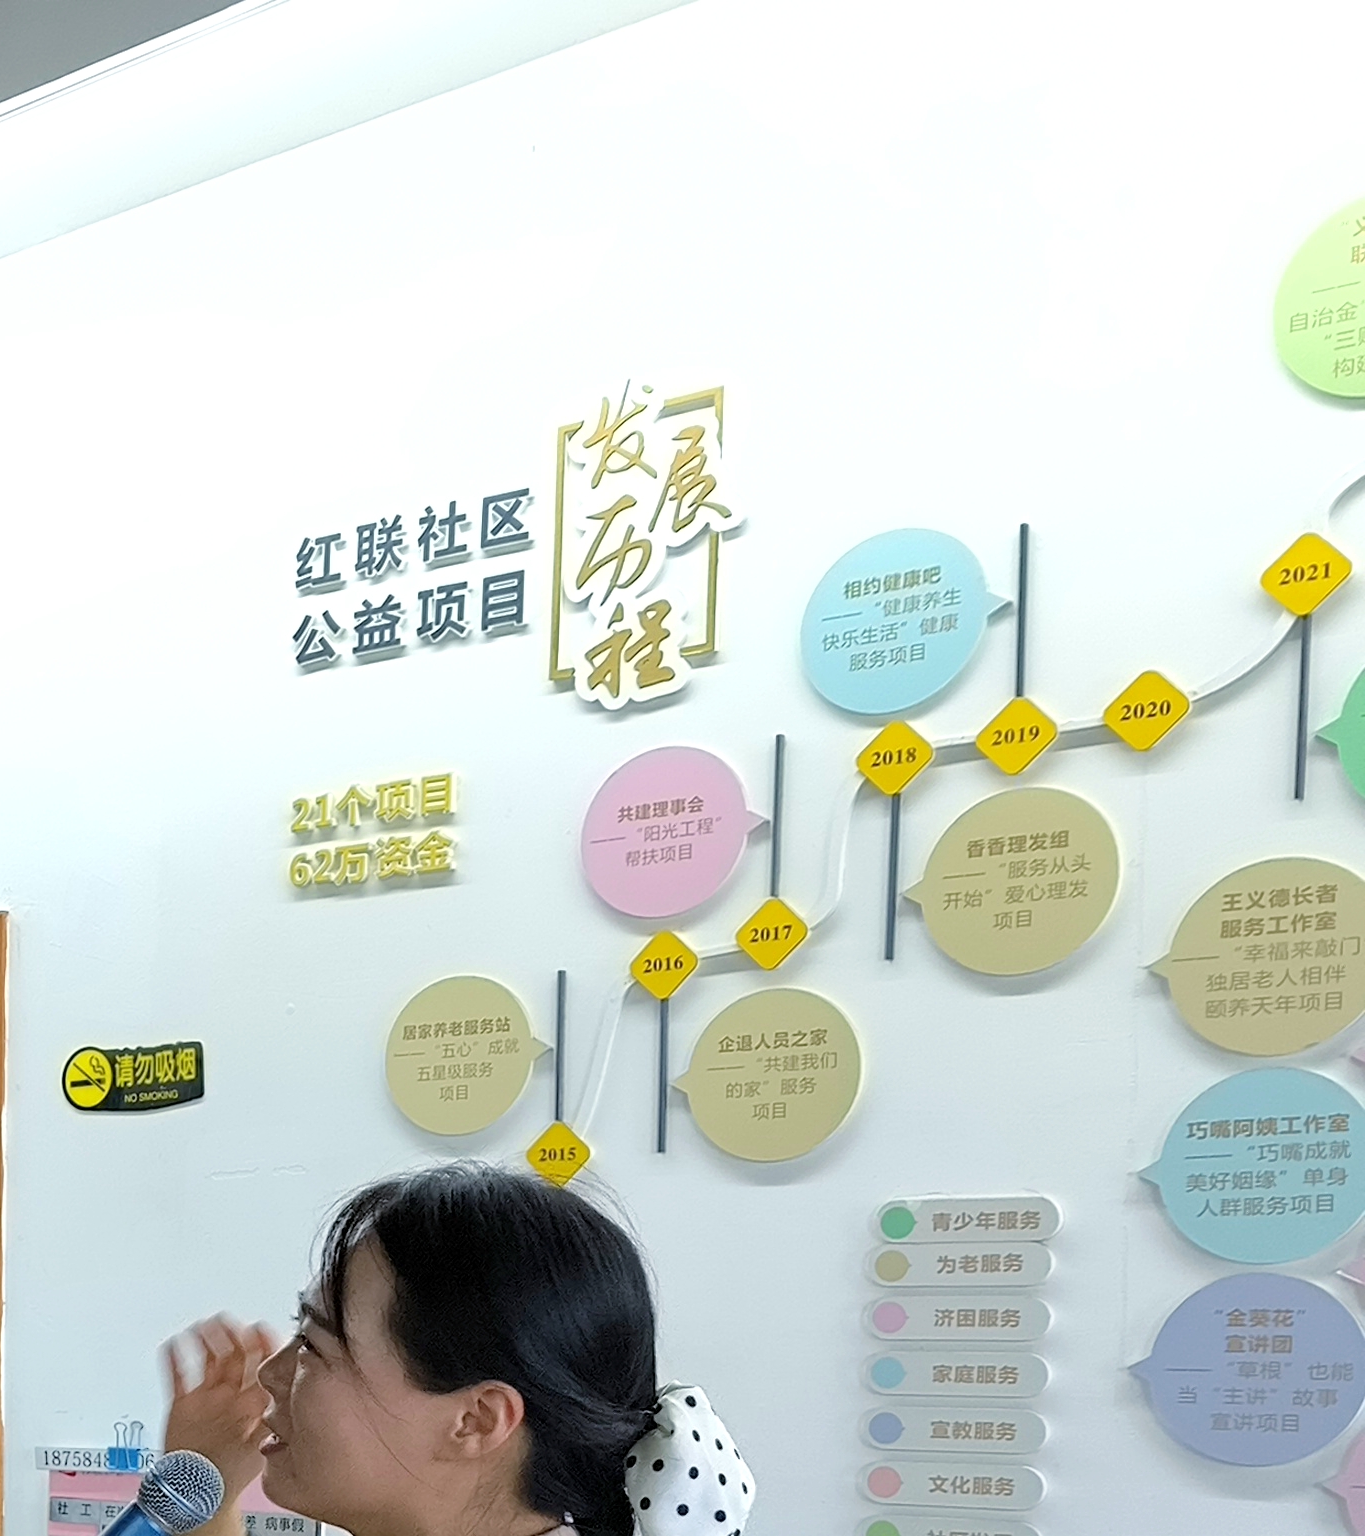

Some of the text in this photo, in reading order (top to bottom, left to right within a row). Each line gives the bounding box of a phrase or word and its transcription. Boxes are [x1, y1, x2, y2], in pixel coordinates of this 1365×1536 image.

[295, 487, 531, 589] 红联社区
[576, 379, 731, 698] 发展历程
[843, 565, 942, 599] 相约健康吧
[1278, 561, 1333, 586] 2021
[292, 569, 527, 666] 公益项目
[849, 642, 925, 671] 服务项目
[1119, 699, 1172, 721] 2020
[991, 725, 1041, 747] 2019
[869, 747, 918, 767] 2018
[291, 774, 455, 833] 21个项目
[618, 796, 704, 823] 共建理事会
[625, 843, 692, 867] 帮扶项目
[967, 830, 1070, 858] 香香理发组
[288, 830, 454, 888] 62万资金
[1221, 883, 1338, 912] 王义德长者
[992, 909, 1032, 930] 项目
[1220, 911, 1337, 938] 服务工作室
[749, 924, 793, 943] 2017
[642, 954, 684, 974] 2016
[1205, 964, 1347, 992] 独居老人相伴
[1205, 991, 1343, 1018] 颐养天年项目
[402, 1016, 511, 1040] 居家养老服务站
[718, 1028, 828, 1053] 企退人员之家
[115, 1047, 196, 1088] 请勿吸烟
[416, 1062, 494, 1082] 五星级服务
[124, 1088, 179, 1103] NO SMOKING
[439, 1084, 469, 1102] 项目
[751, 1102, 787, 1121] 项目
[1186, 1112, 1350, 1140] 巧嘴阿姨工作室
[539, 1146, 577, 1163] 2015
[1196, 1193, 1334, 1218] 人群服务项目
[931, 1210, 1041, 1232] 青少年服务
[936, 1253, 1024, 1275] 为老服务
[933, 1308, 1022, 1329] 济困服务
[1224, 1334, 1293, 1353] 宣讲团
[932, 1364, 1020, 1385] 家庭服务
[929, 1420, 1018, 1442] 宣教服务
[1210, 1413, 1300, 1432] 宣讲项目
[928, 1475, 1016, 1497] 文化服务
